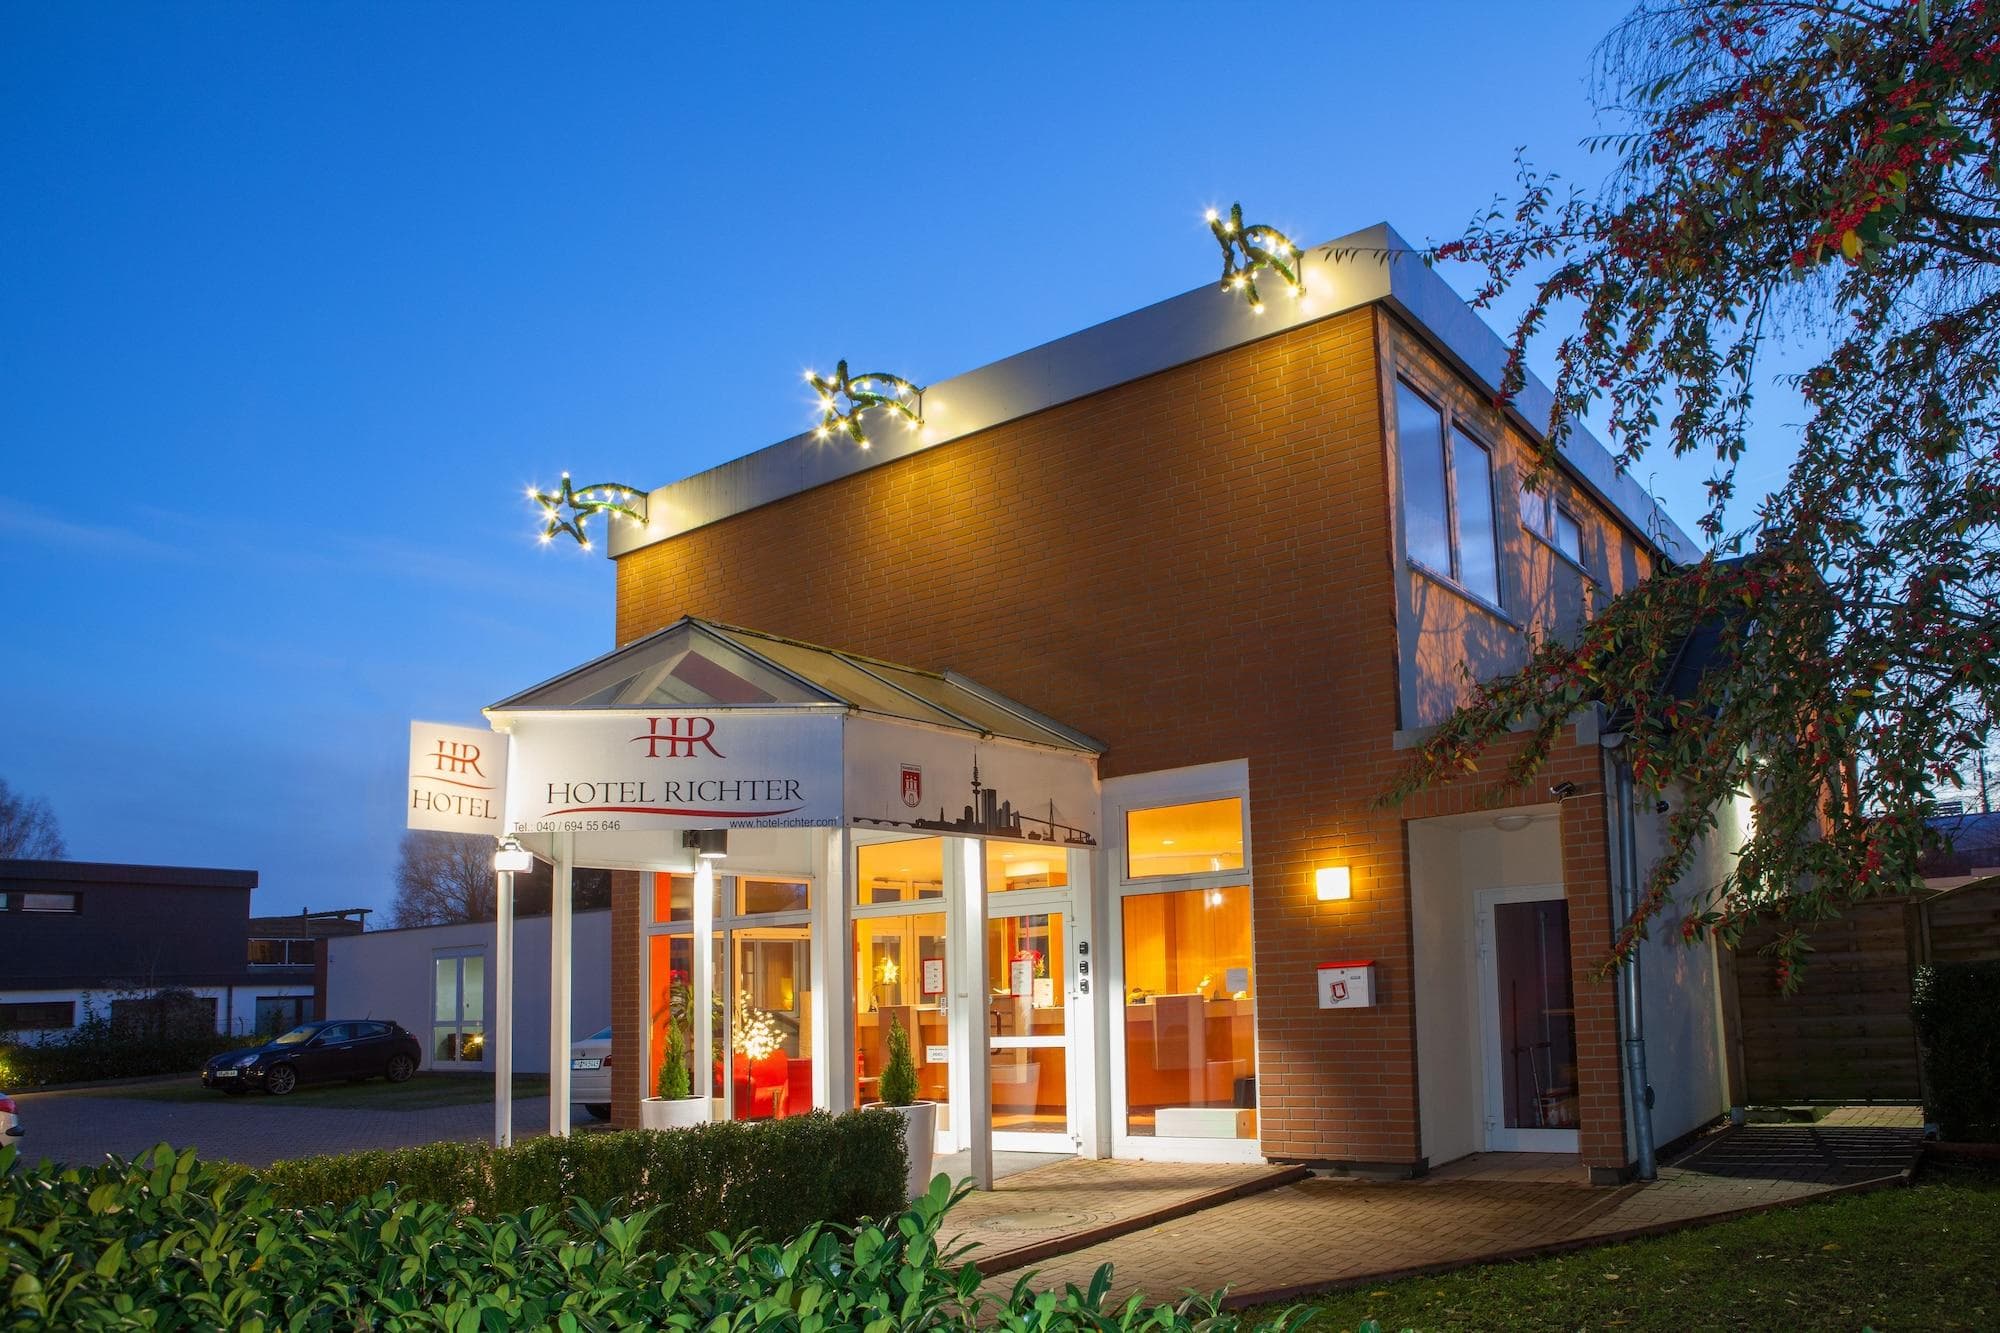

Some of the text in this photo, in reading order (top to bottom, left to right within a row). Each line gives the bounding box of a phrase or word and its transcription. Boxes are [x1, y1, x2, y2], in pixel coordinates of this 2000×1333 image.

[628, 716, 727, 759] HR
[424, 740, 487, 778] HR
[412, 789, 497, 820] HOTEL
[547, 779, 806, 804] HOTEL RICHTER
[536, 822, 555, 832] 040
[564, 821, 583, 832] 694
[586, 821, 599, 831] 55
[601, 820, 621, 831] 646
[729, 818, 838, 829] www.hotel-richter.com
